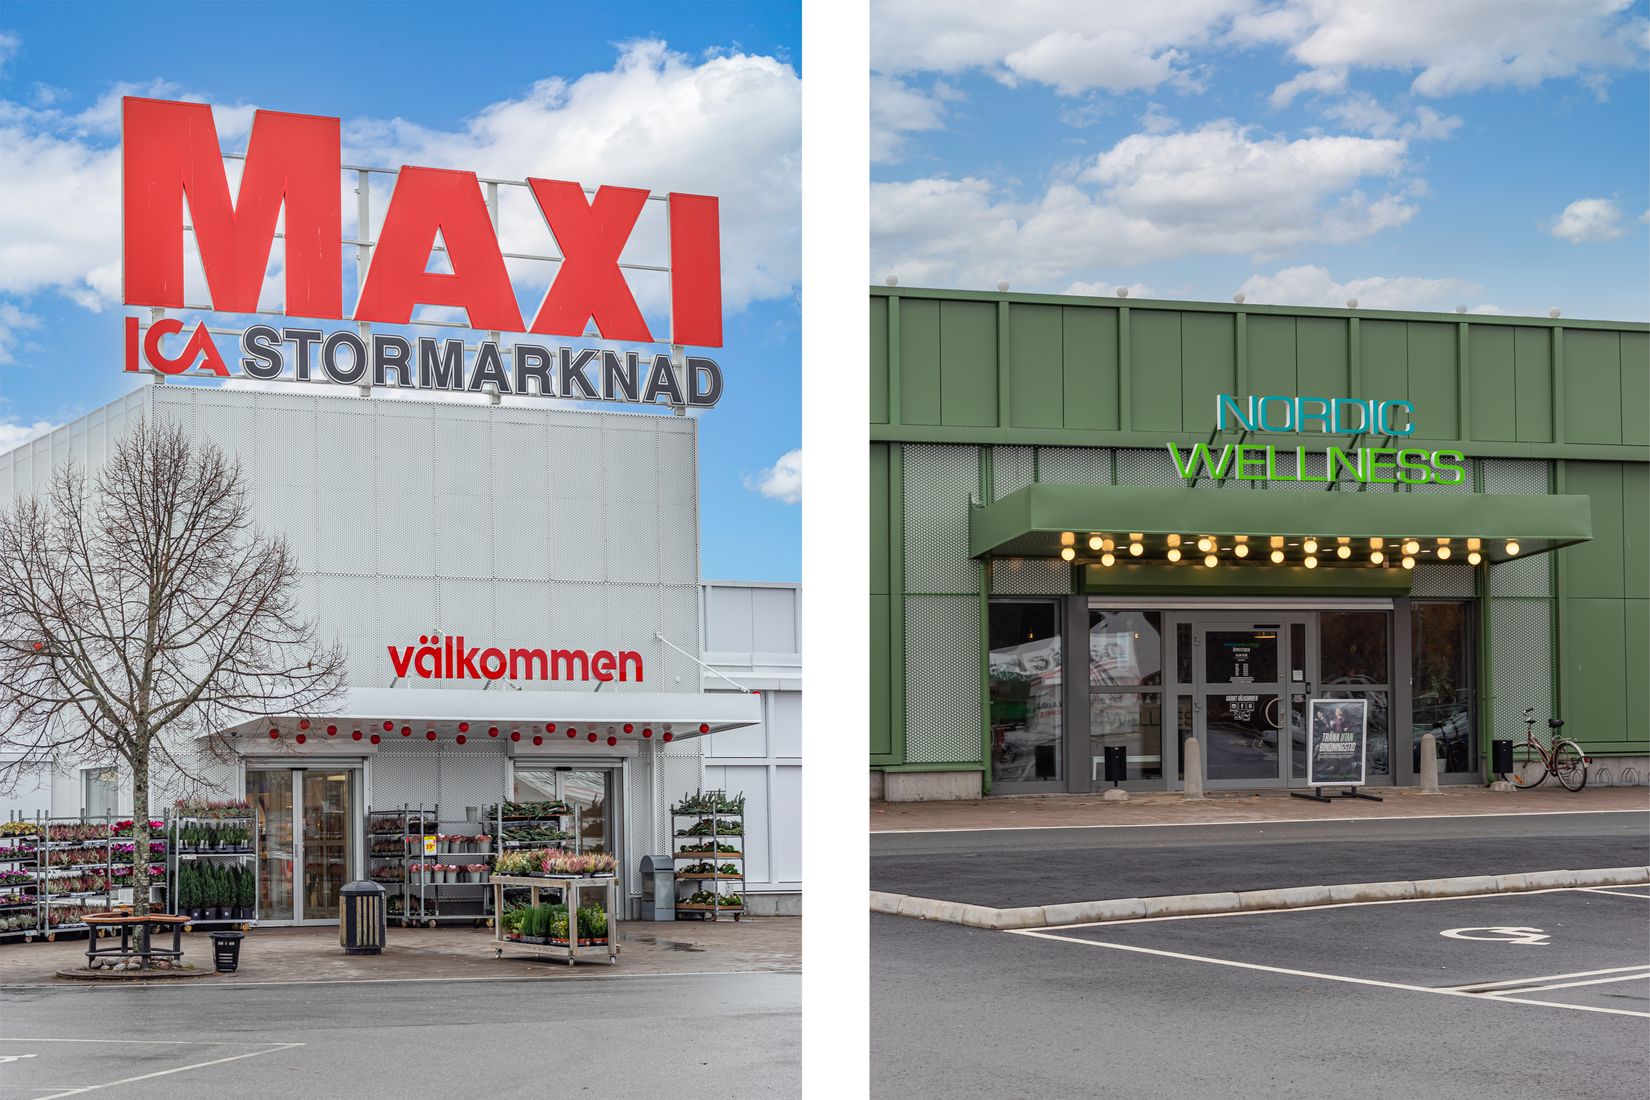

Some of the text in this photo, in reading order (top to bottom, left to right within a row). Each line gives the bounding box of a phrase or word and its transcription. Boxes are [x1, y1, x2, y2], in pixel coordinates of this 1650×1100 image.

[121, 95, 723, 348] MAXI
[124, 316, 723, 407] ICA STORMARKNAD
[1216, 394, 1415, 436] NORDIC
[1166, 442, 1466, 485] WELLNESS
[387, 634, 644, 682] välkommen
